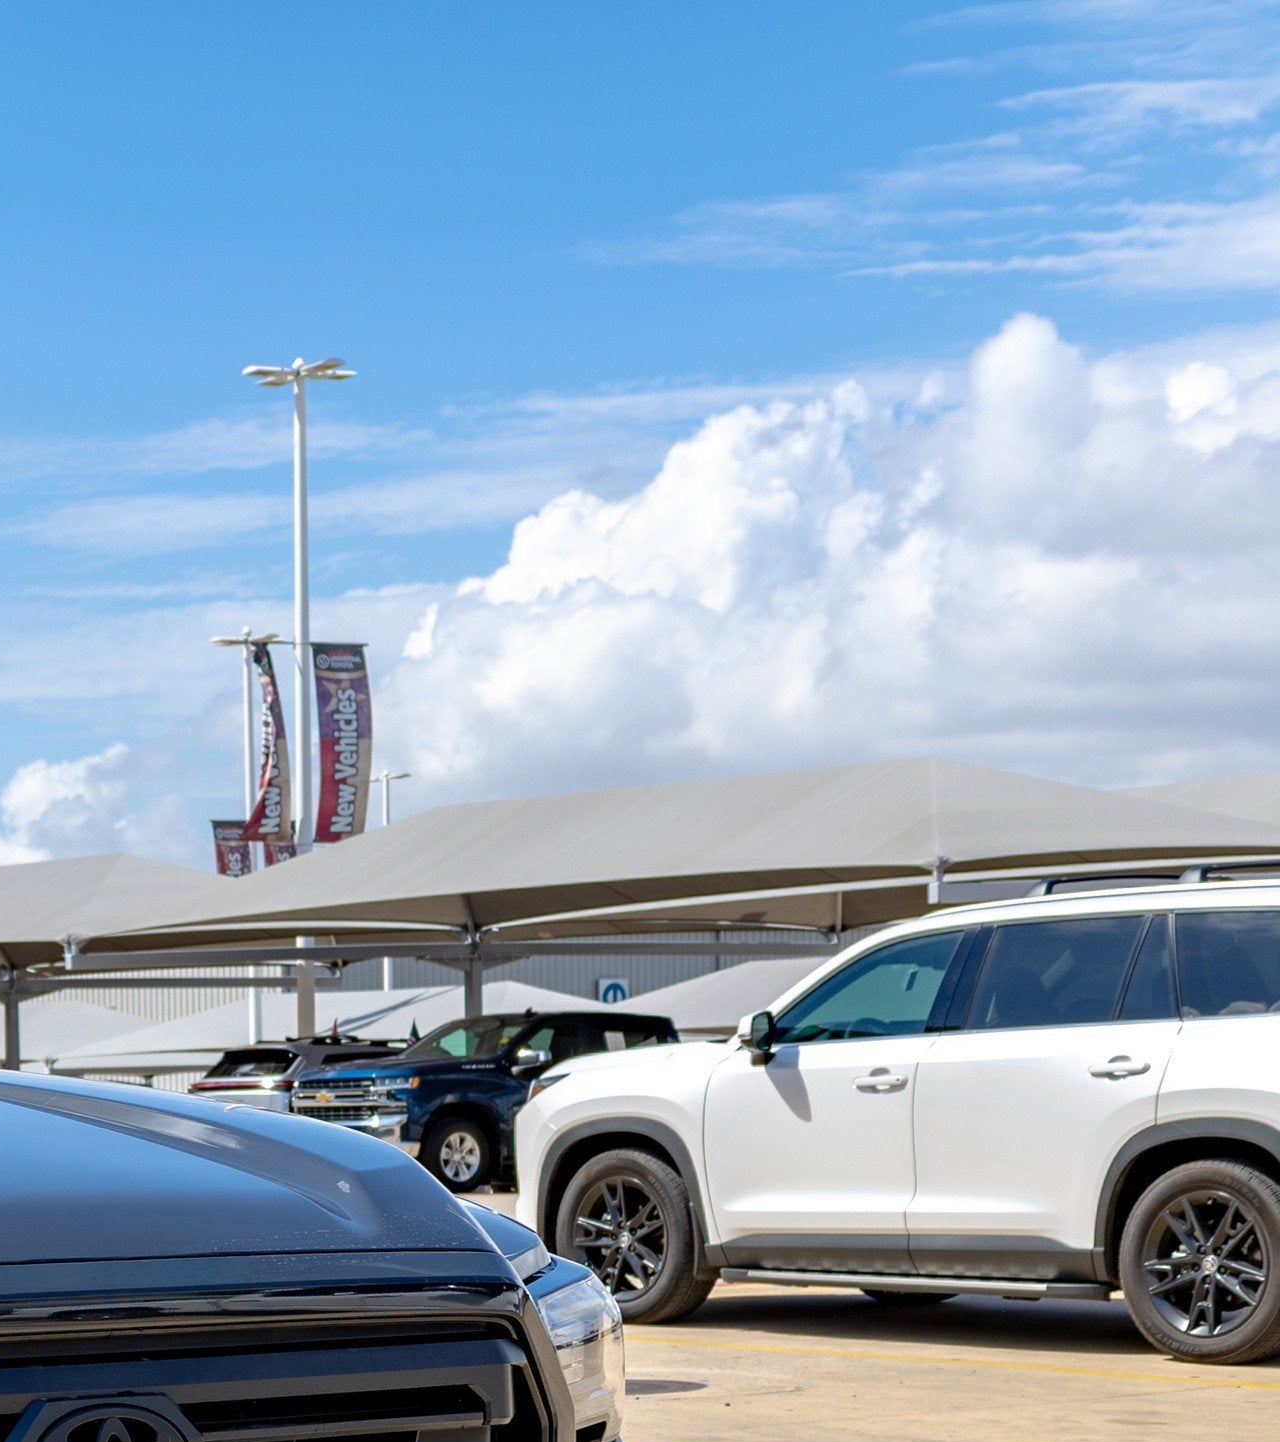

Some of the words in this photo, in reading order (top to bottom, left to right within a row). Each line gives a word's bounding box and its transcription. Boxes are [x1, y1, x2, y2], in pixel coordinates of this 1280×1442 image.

[333, 688, 358, 780] Vehicles
[258, 786, 282, 833] New
[329, 783, 356, 833] New
